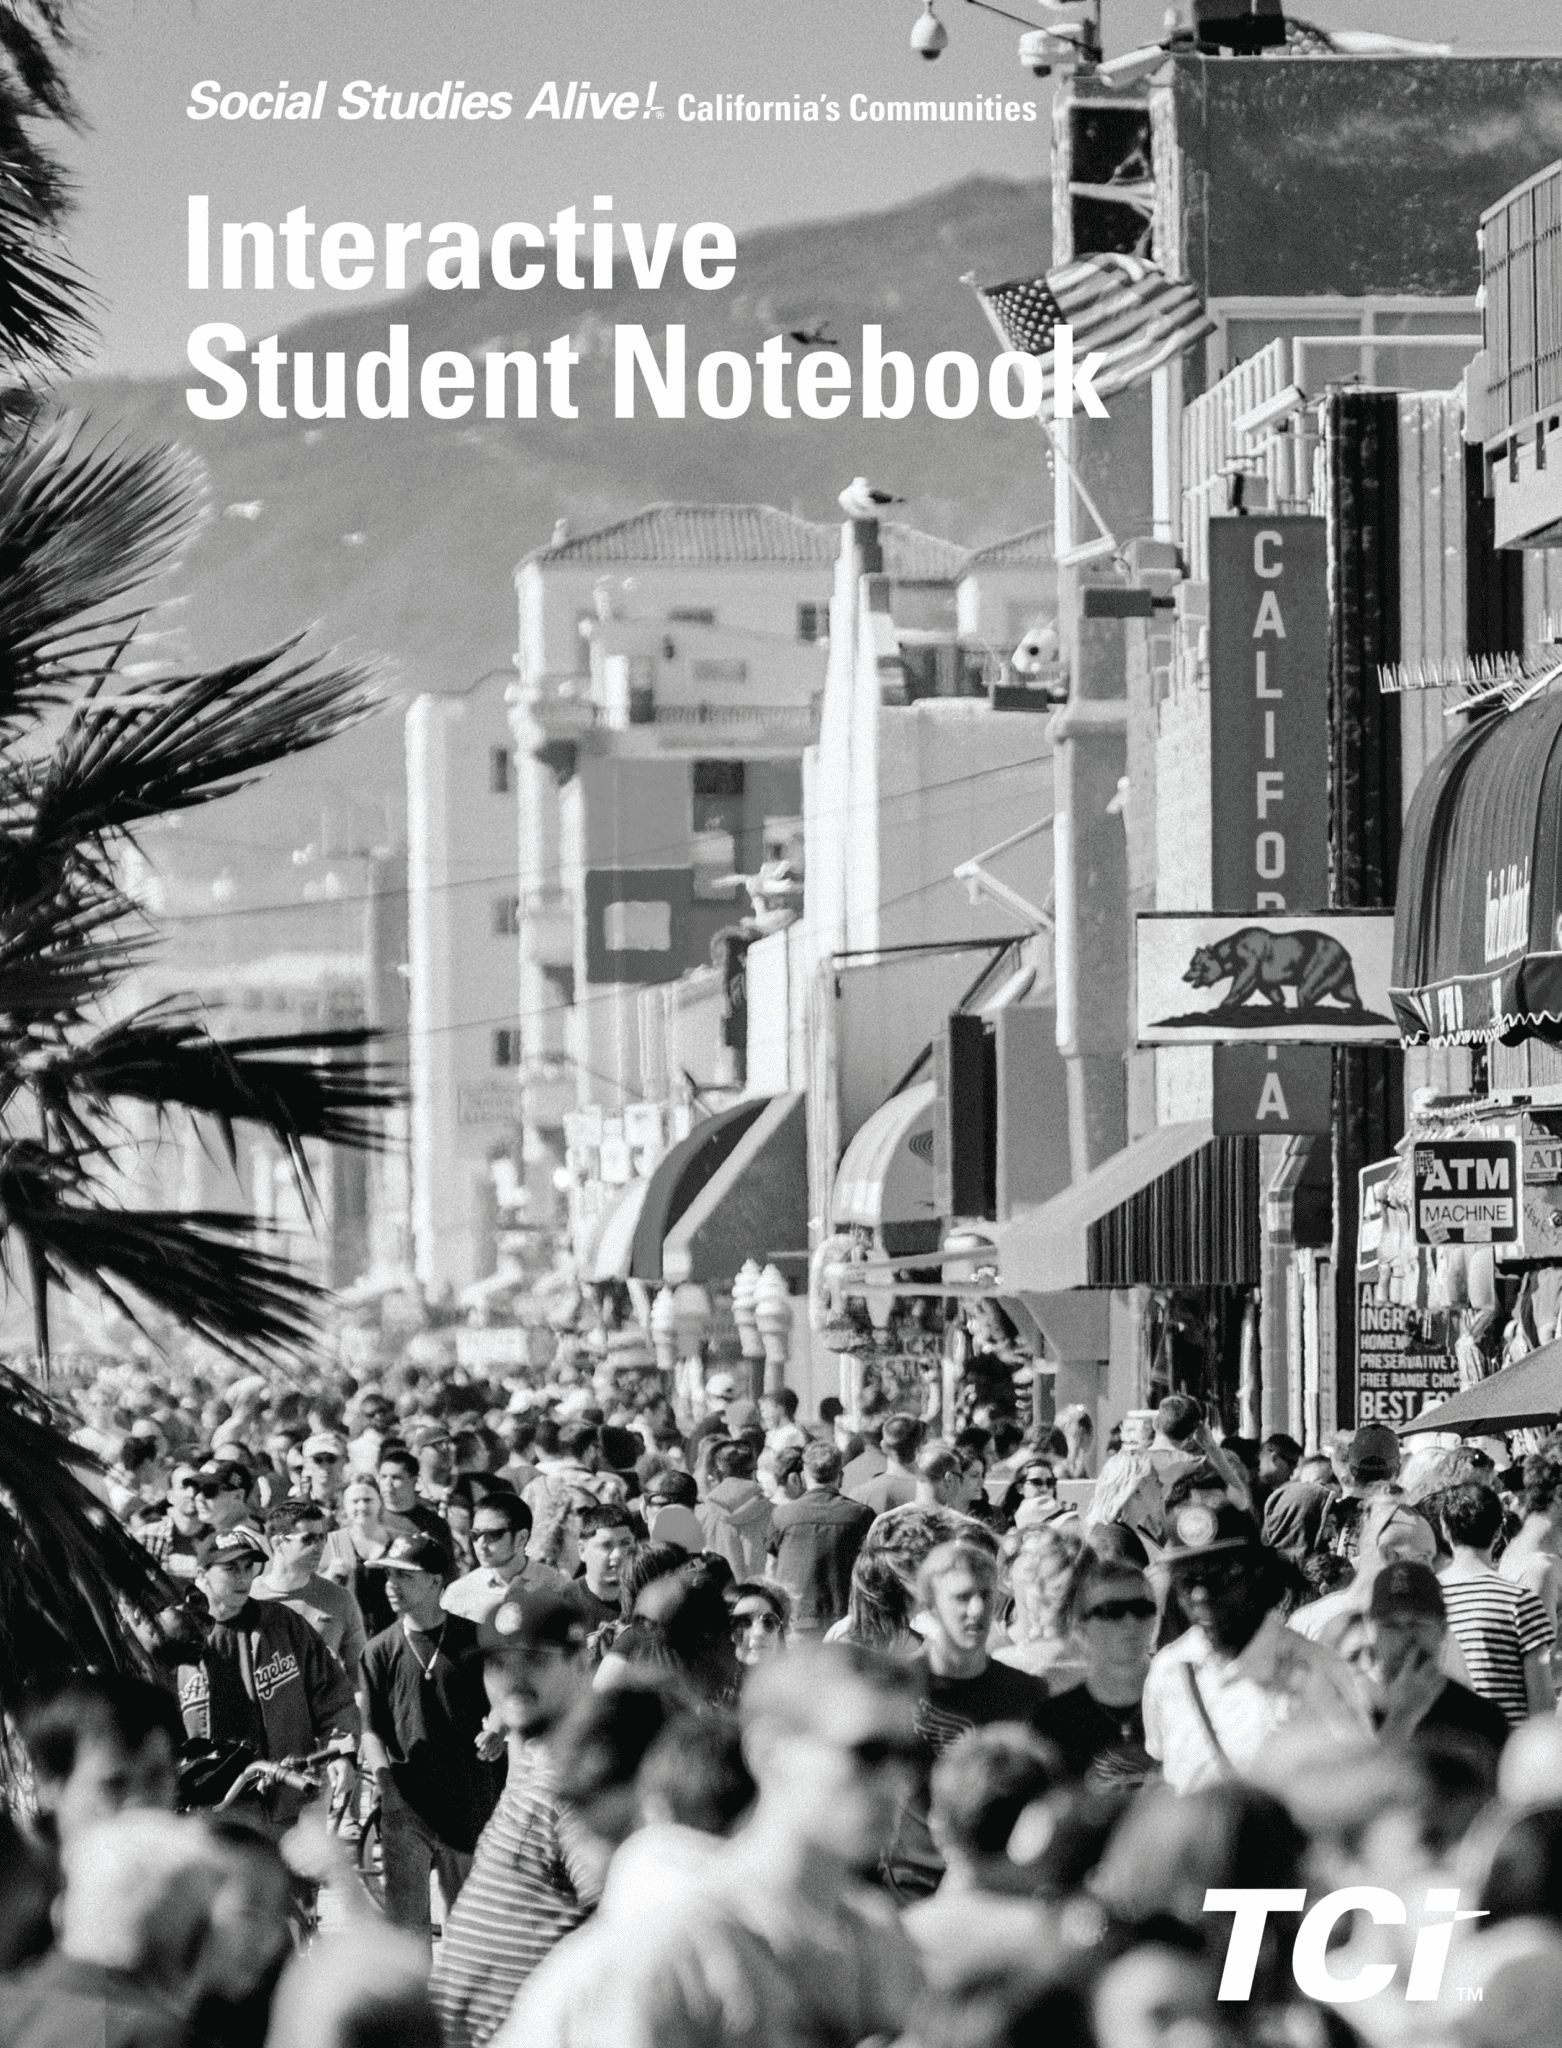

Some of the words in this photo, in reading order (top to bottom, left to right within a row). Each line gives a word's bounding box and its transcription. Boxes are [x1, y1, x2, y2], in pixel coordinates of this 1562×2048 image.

[1422, 1158, 1509, 1191] ATM
[1425, 1205, 1507, 1222] MACHINE
[1360, 1373, 1388, 1388] FREE
[1390, 1373, 1429, 1388] RANGE
[1360, 1391, 1417, 1419] BEST
